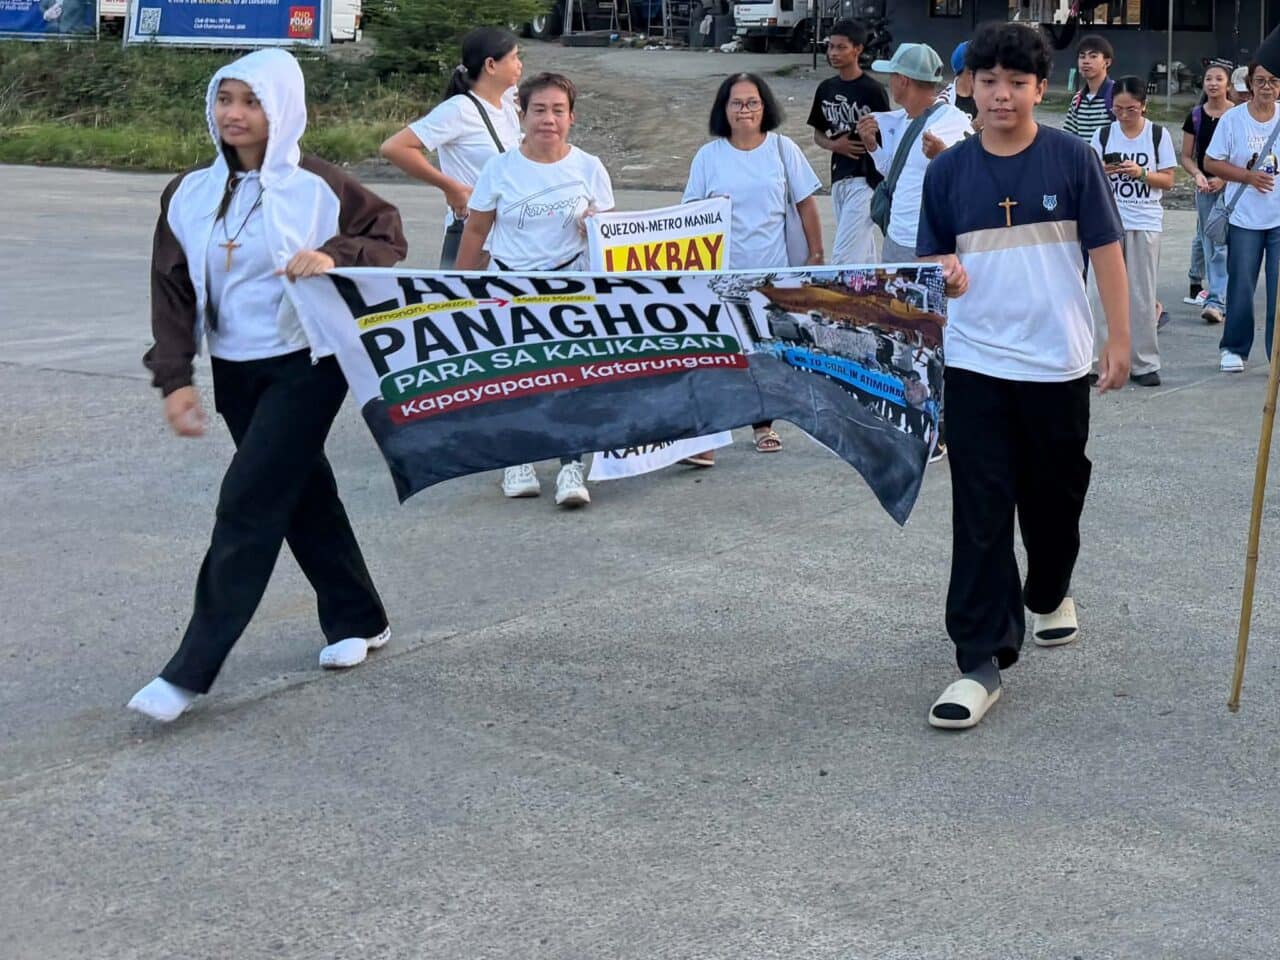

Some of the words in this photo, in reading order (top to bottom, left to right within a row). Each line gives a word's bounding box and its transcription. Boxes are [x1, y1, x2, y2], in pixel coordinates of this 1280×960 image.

[600, 217, 682, 239] QUEZON-METRO
[684, 211, 723, 227] MANILA
[360, 303, 722, 379] PANAGHOY
[394, 358, 486, 394] PARA
[490, 349, 537, 369] SA
[543, 336, 726, 361] KALIKASAN
[400, 372, 575, 417] Kapayapaan.
[580, 354, 737, 380] Katarungan!
